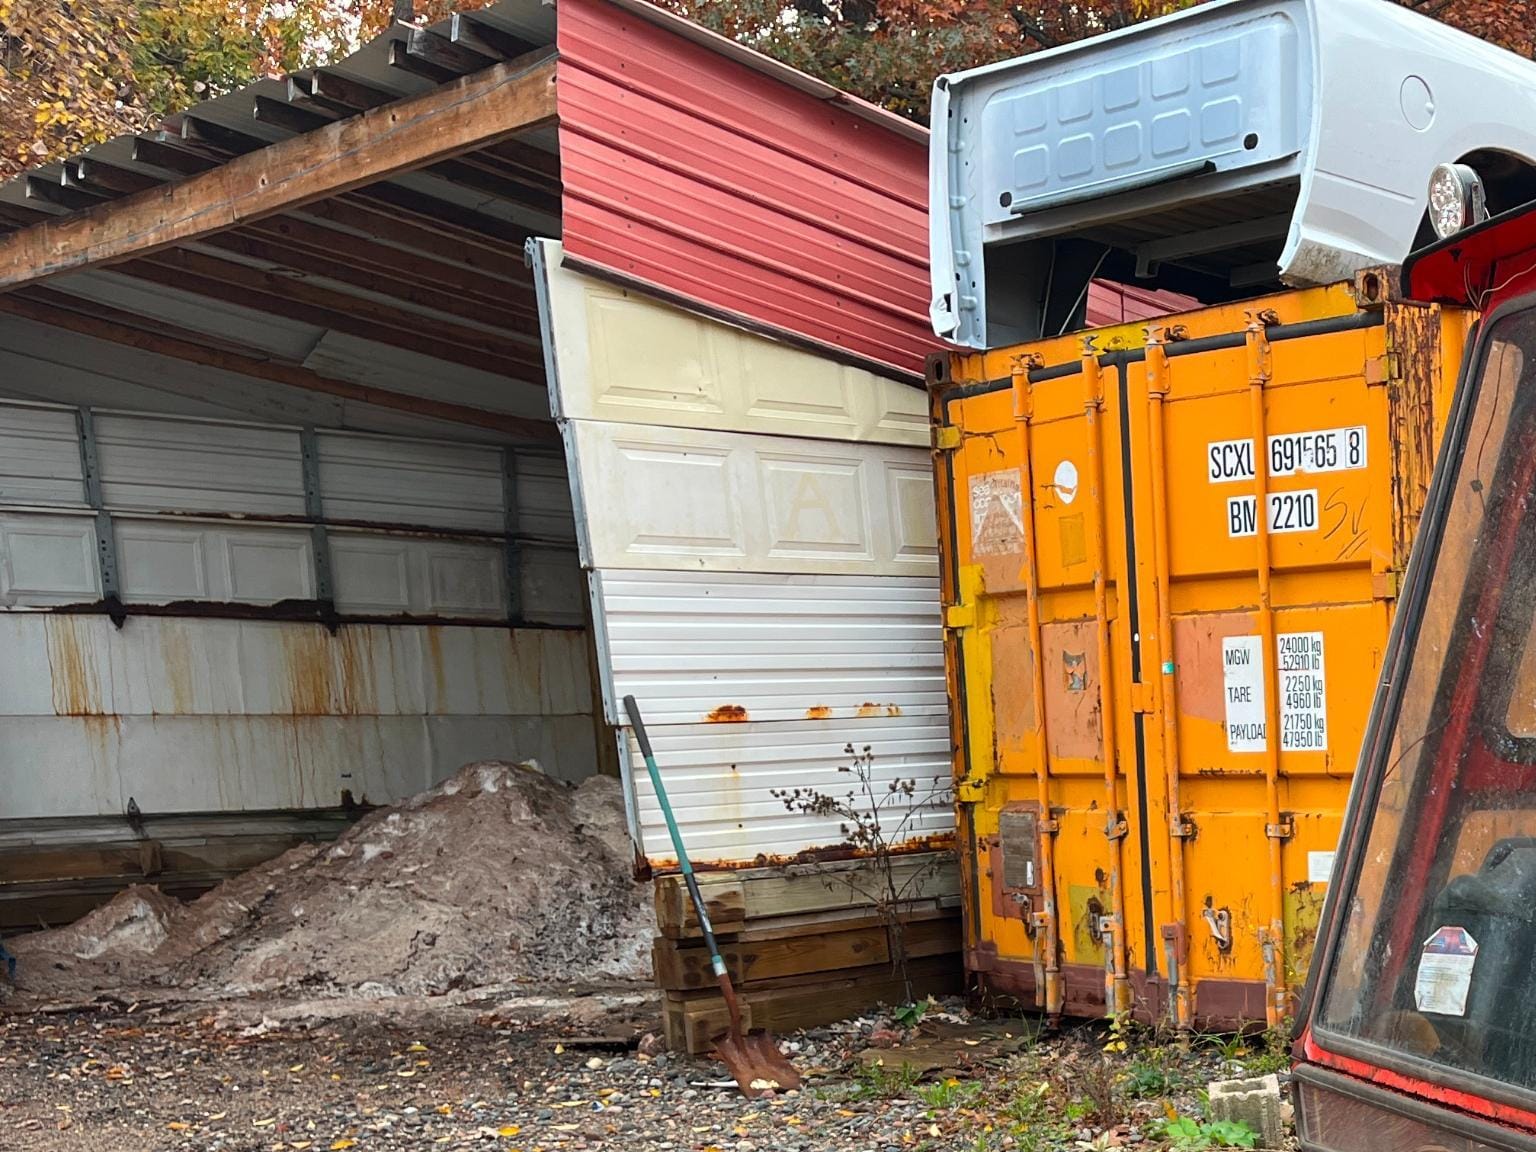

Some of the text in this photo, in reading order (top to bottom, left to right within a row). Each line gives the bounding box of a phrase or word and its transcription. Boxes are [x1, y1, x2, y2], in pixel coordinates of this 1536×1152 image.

[1350, 431, 1360, 465] 8
[1272, 494, 1315, 529] 2210
[1225, 637, 1321, 665] MGW 24000 kg
[1283, 655, 1320, 671] 52910 lb
[1228, 675, 1323, 703] TARE 2250 kg
[1286, 693, 1321, 709] 4960 lb
[1284, 714, 1312, 731] 21750
[1315, 714, 1325, 733] kg
[1283, 731, 1323, 747] 47950 lb
